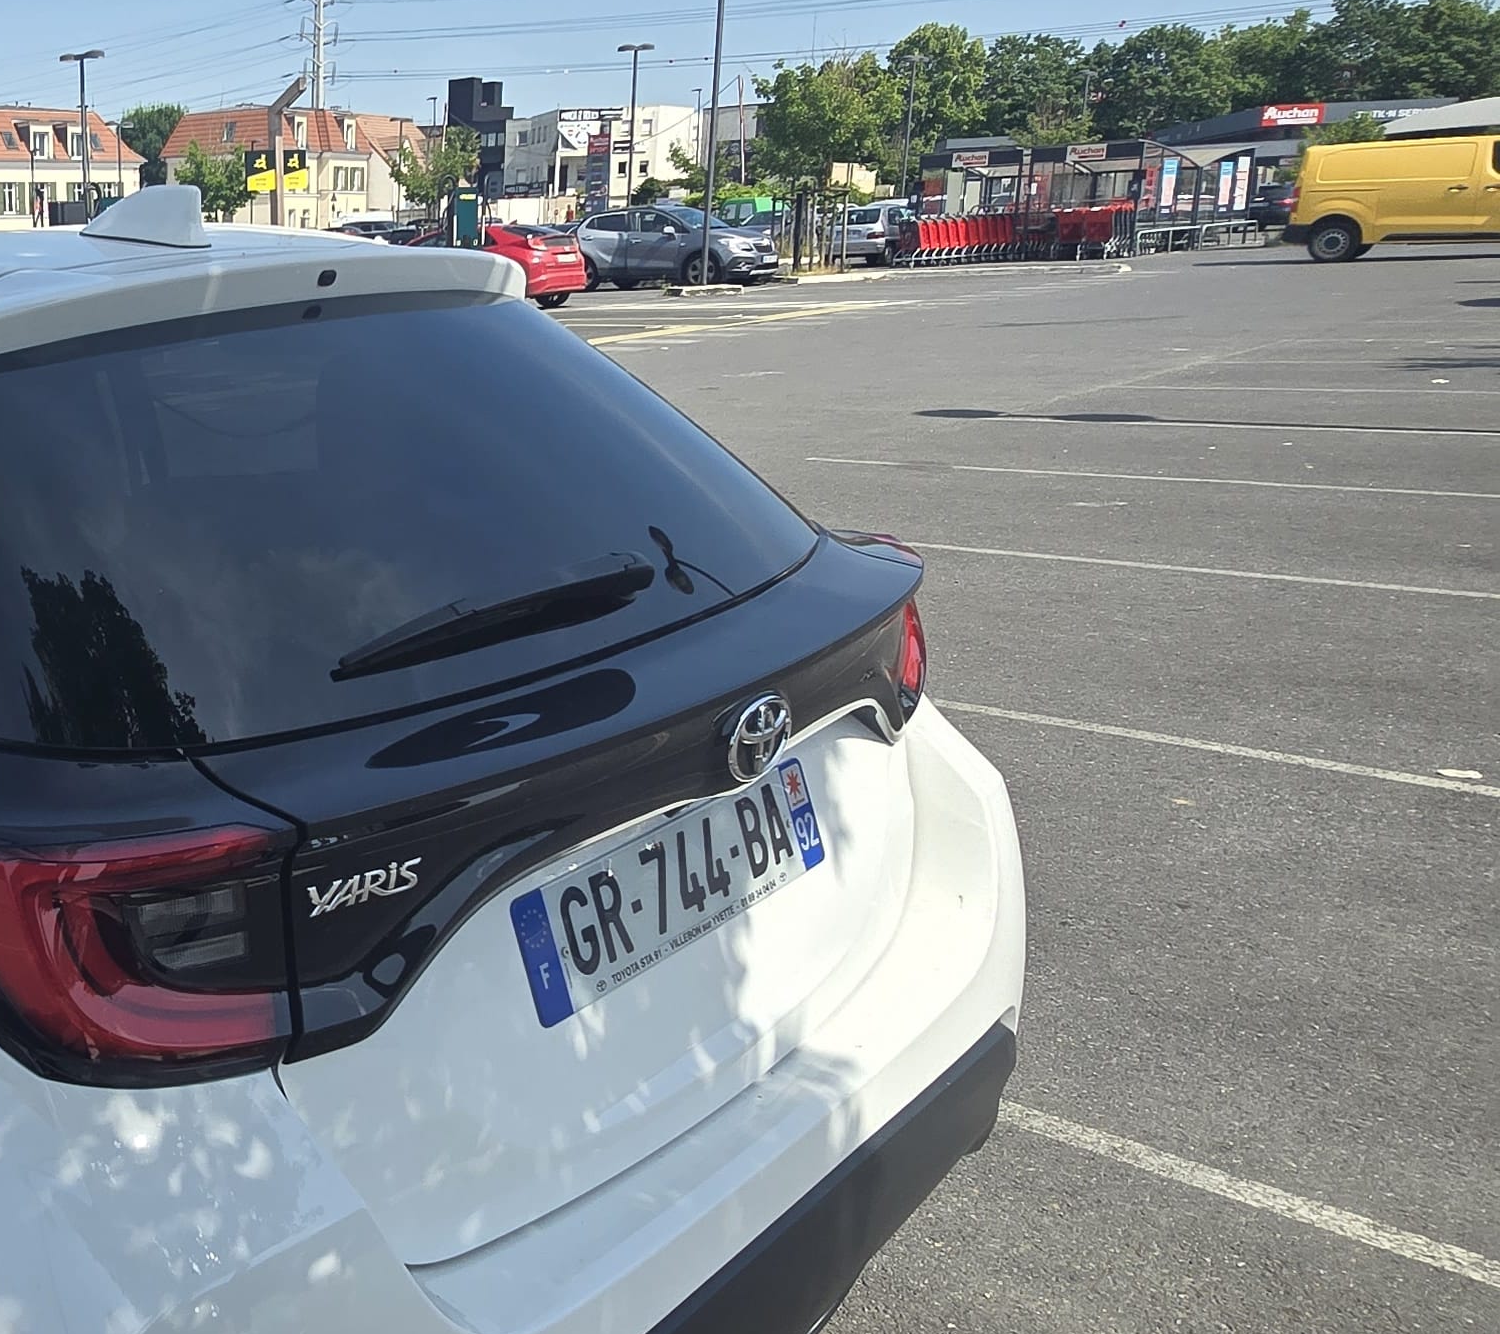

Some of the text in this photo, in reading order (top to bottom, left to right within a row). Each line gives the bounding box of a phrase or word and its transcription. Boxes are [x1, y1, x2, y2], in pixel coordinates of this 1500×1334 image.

[1263, 106, 1319, 120] Auchan
[955, 154, 987, 163] Auchan
[1069, 147, 1104, 156] Auchan
[796, 812, 819, 850] 92
[560, 784, 794, 975] GR-744-BA
[612, 961, 640, 984] TOYOTA
[640, 953, 654, 968] STA
[669, 926, 701, 950] VILLEBON
[712, 905, 735, 924] YVETTE
[540, 963, 550, 989] F
